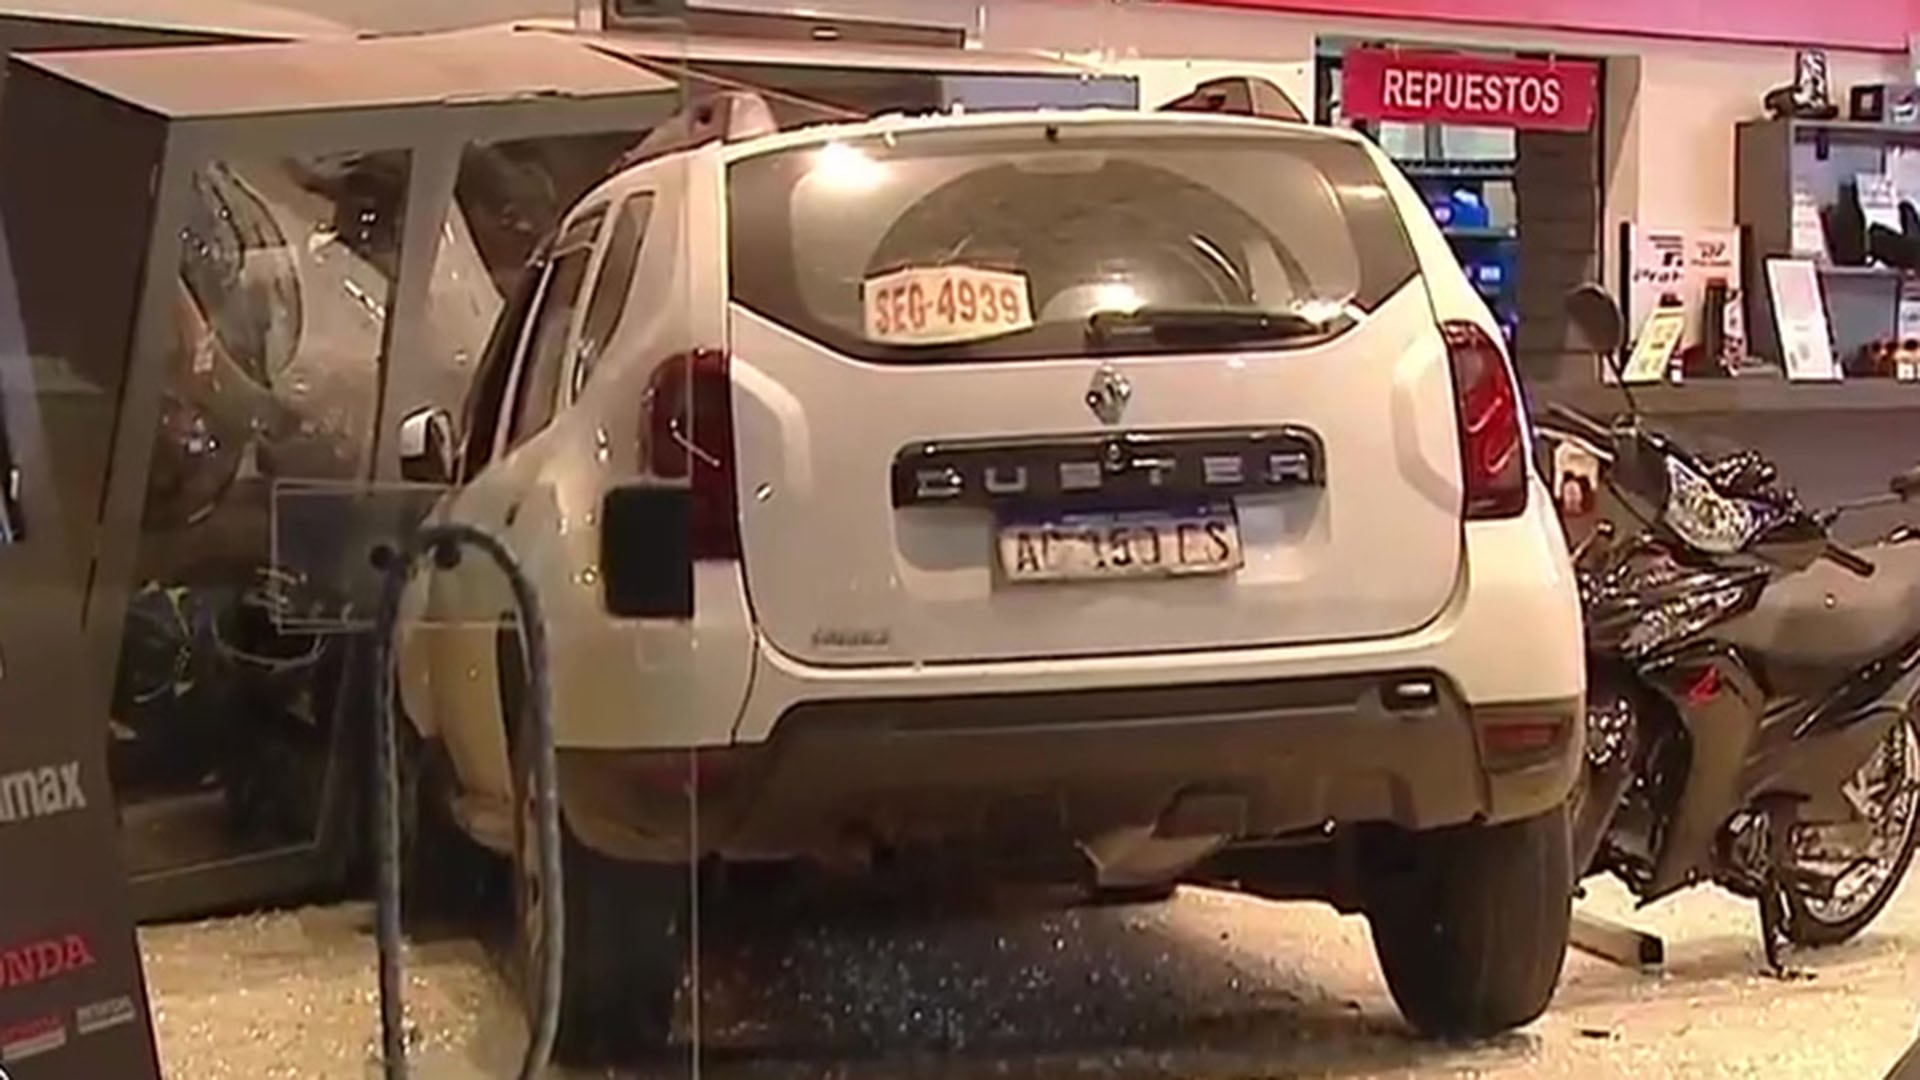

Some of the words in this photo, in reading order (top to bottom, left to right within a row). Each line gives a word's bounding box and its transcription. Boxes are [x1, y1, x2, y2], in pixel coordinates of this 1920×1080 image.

[1383, 68, 1562, 115] REPUESTOS
[875, 277, 1021, 335] SEG-4939
[916, 453, 1310, 498] DUSTER
[0, 760, 87, 820] max
[0, 934, 96, 988] NDA
